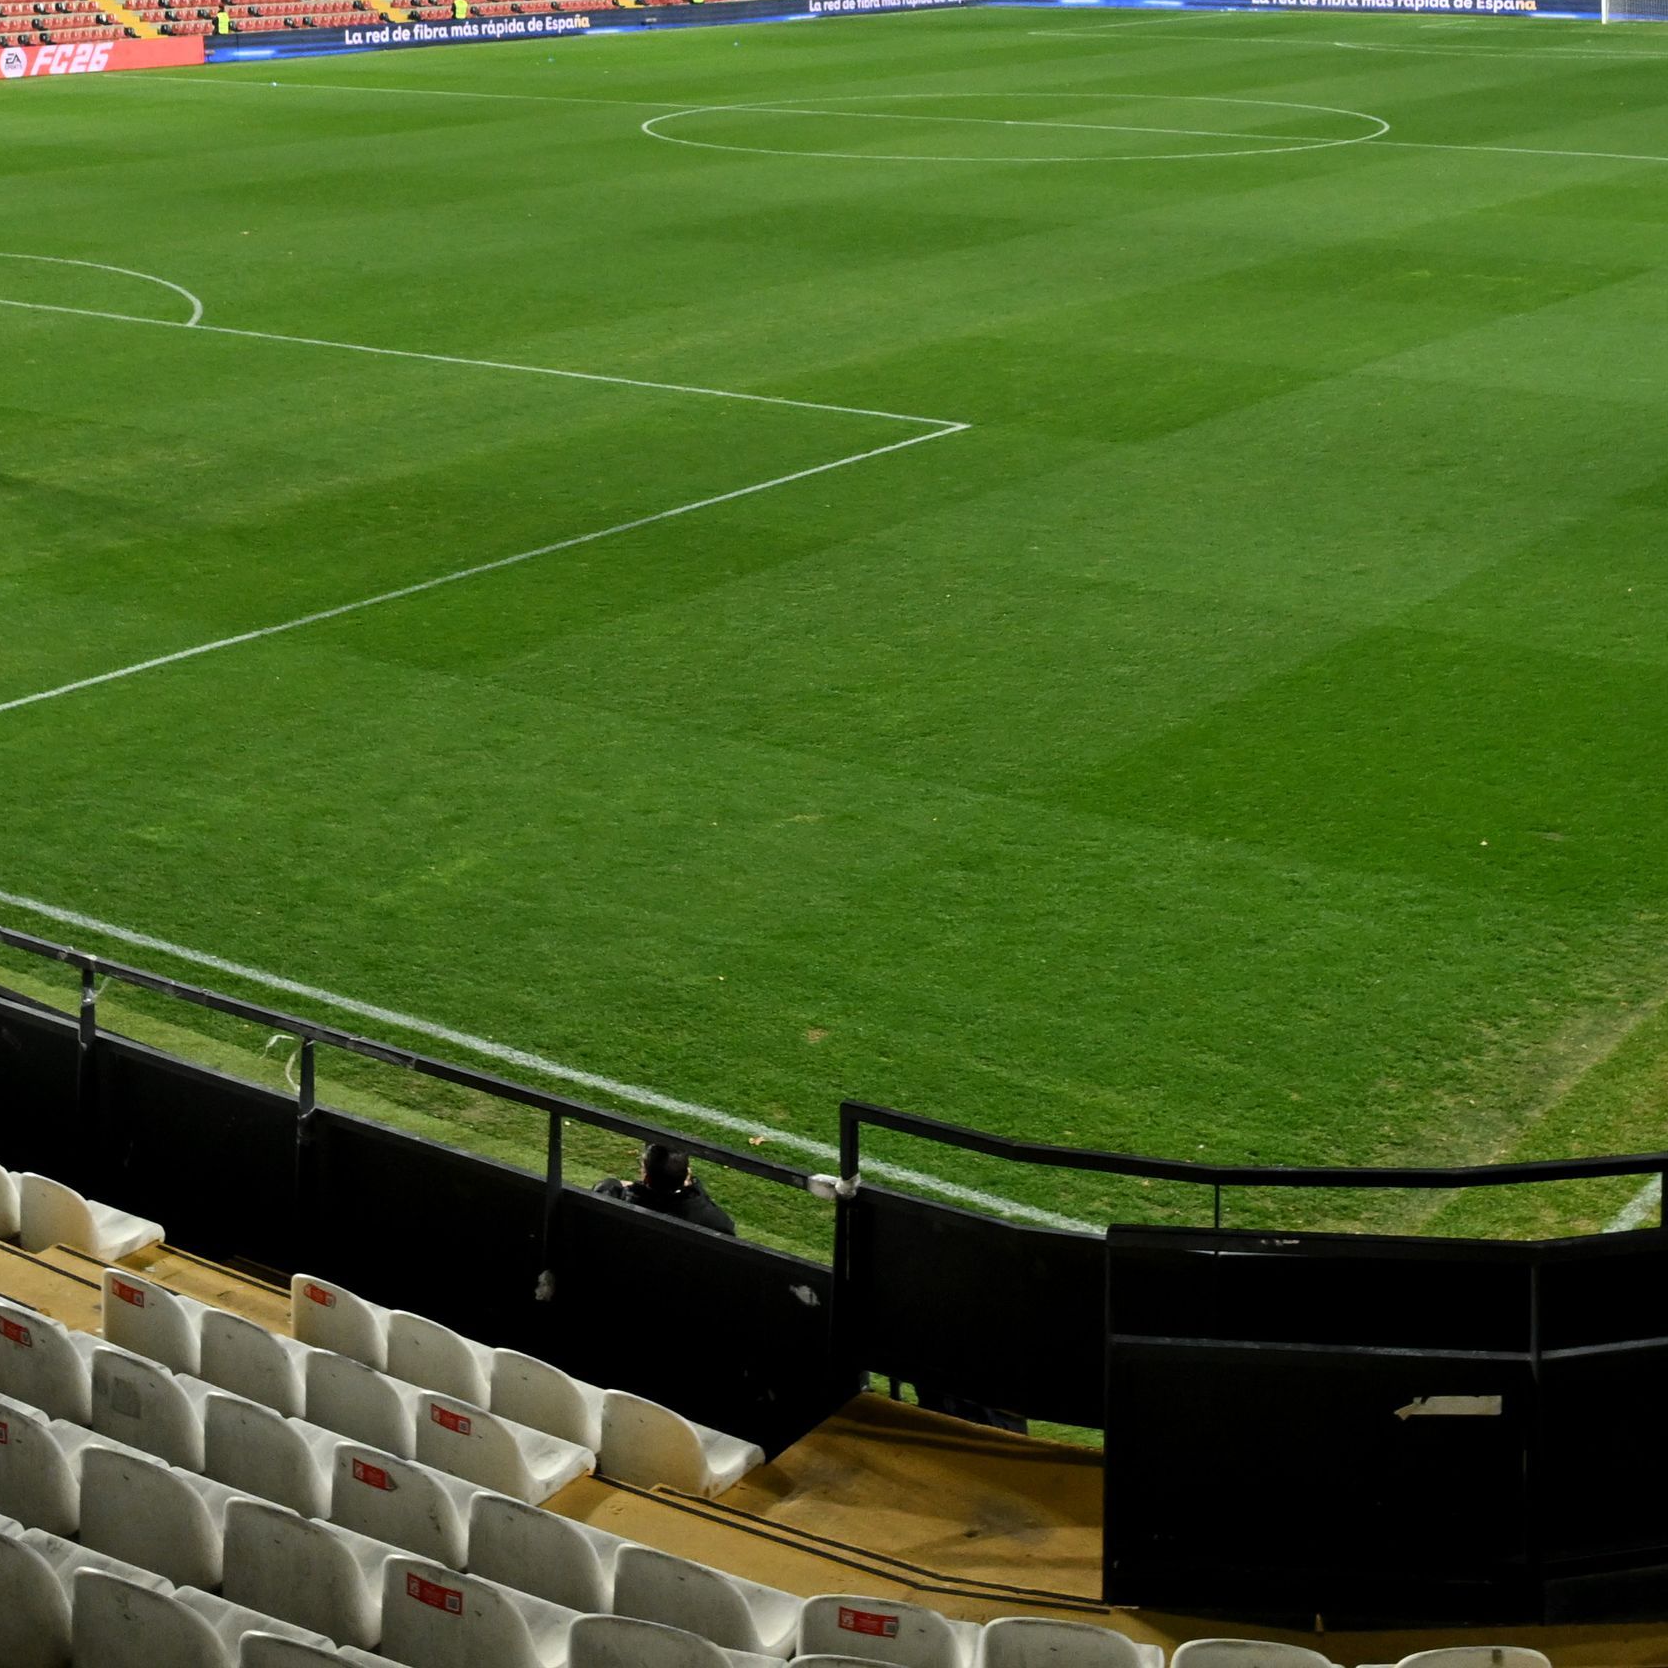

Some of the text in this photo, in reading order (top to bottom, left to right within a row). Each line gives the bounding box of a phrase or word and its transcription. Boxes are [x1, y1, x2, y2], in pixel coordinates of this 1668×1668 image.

[809, 0, 822, 12] La
[345, 13, 591, 45] La red de fibra más rápida de España
